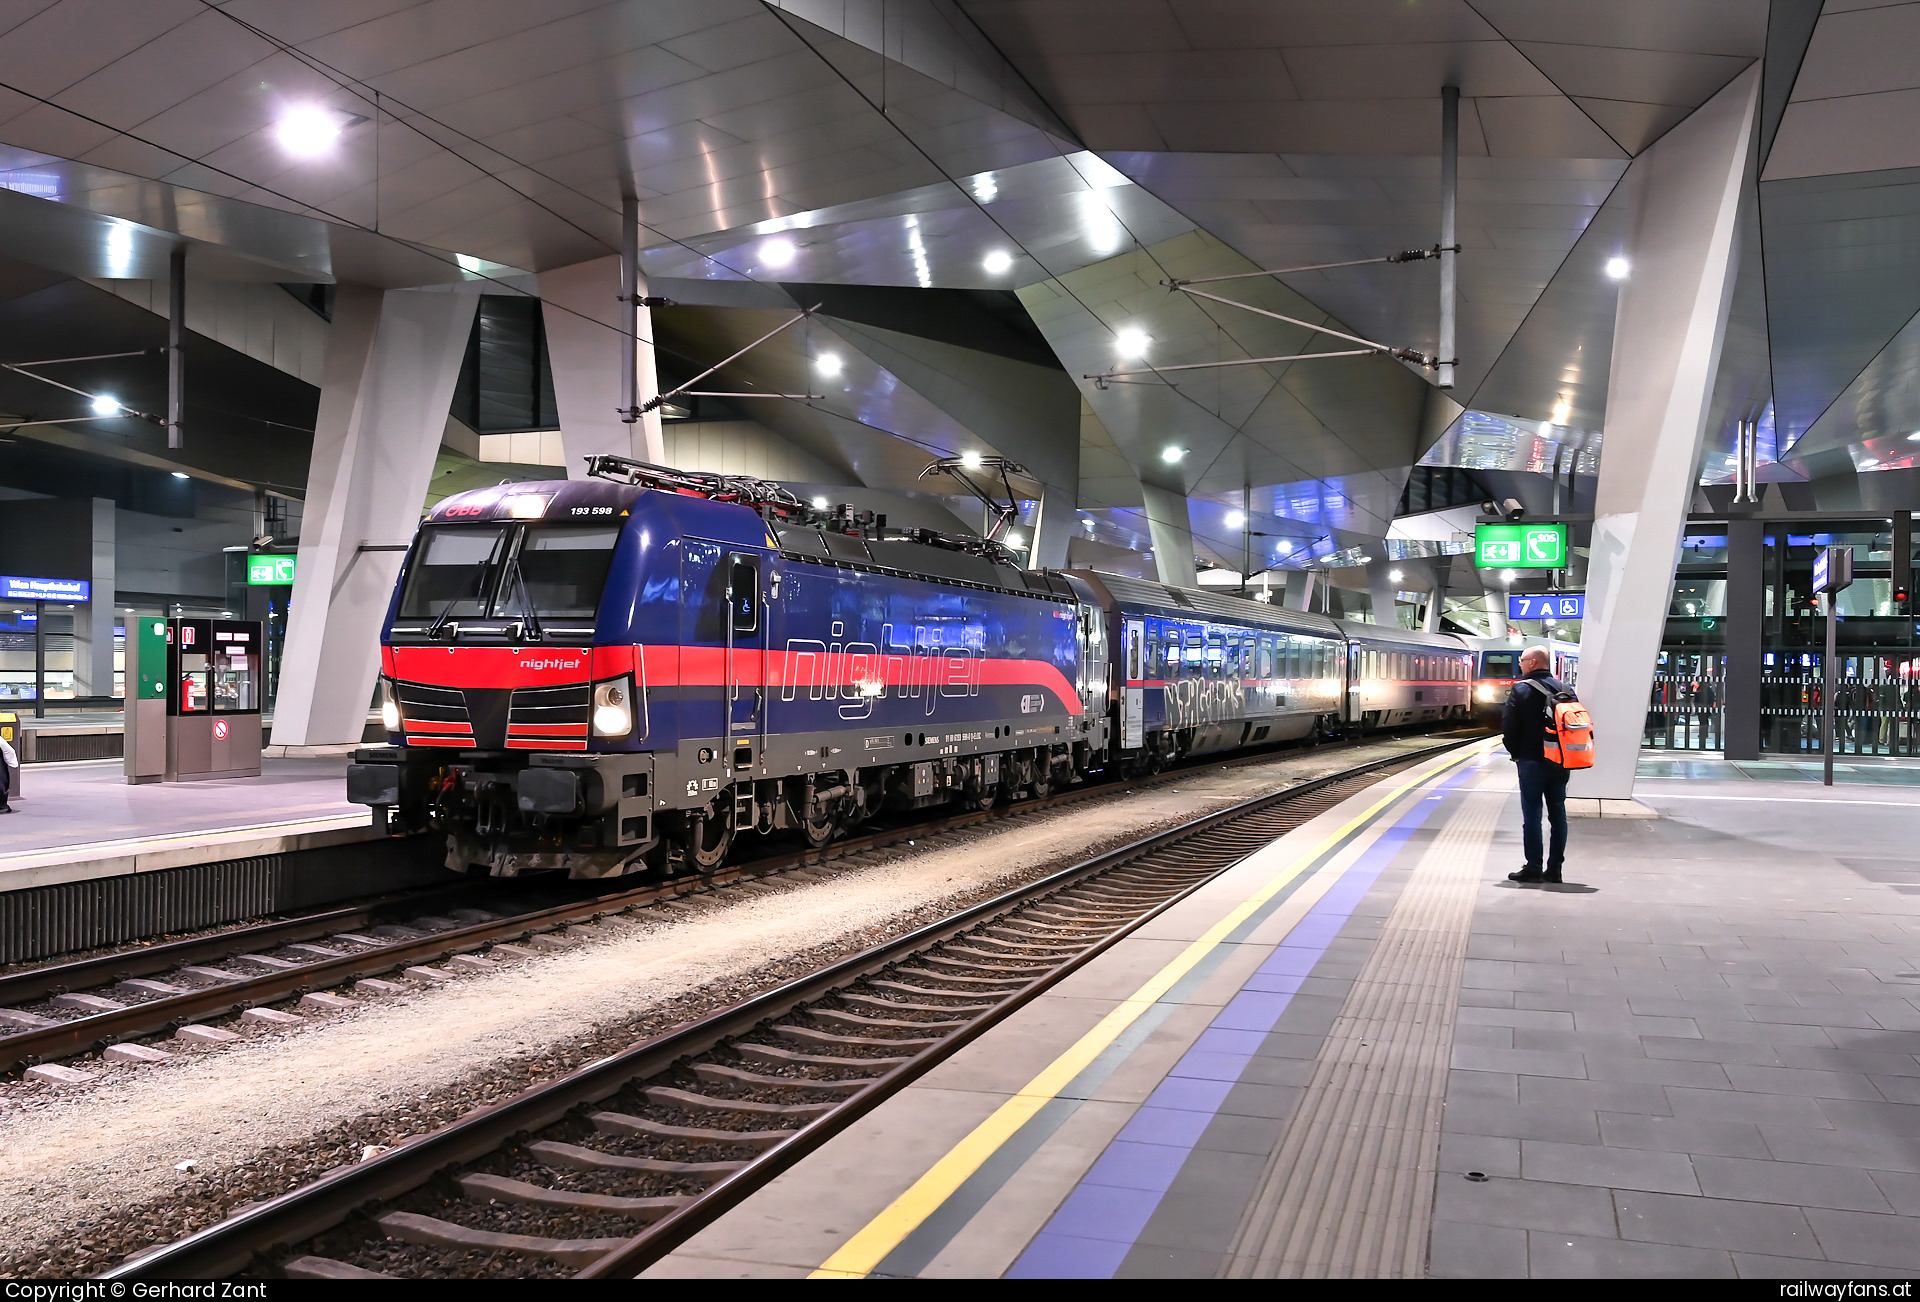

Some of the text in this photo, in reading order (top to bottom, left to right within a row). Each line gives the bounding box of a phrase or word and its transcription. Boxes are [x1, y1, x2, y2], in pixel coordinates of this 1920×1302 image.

[570, 507, 613, 516] 193 598
[1536, 533, 1557, 543] SOS
[1518, 599, 1554, 616] 7 A
[520, 658, 581, 670] nightjet
[781, 620, 986, 720] nightjet
